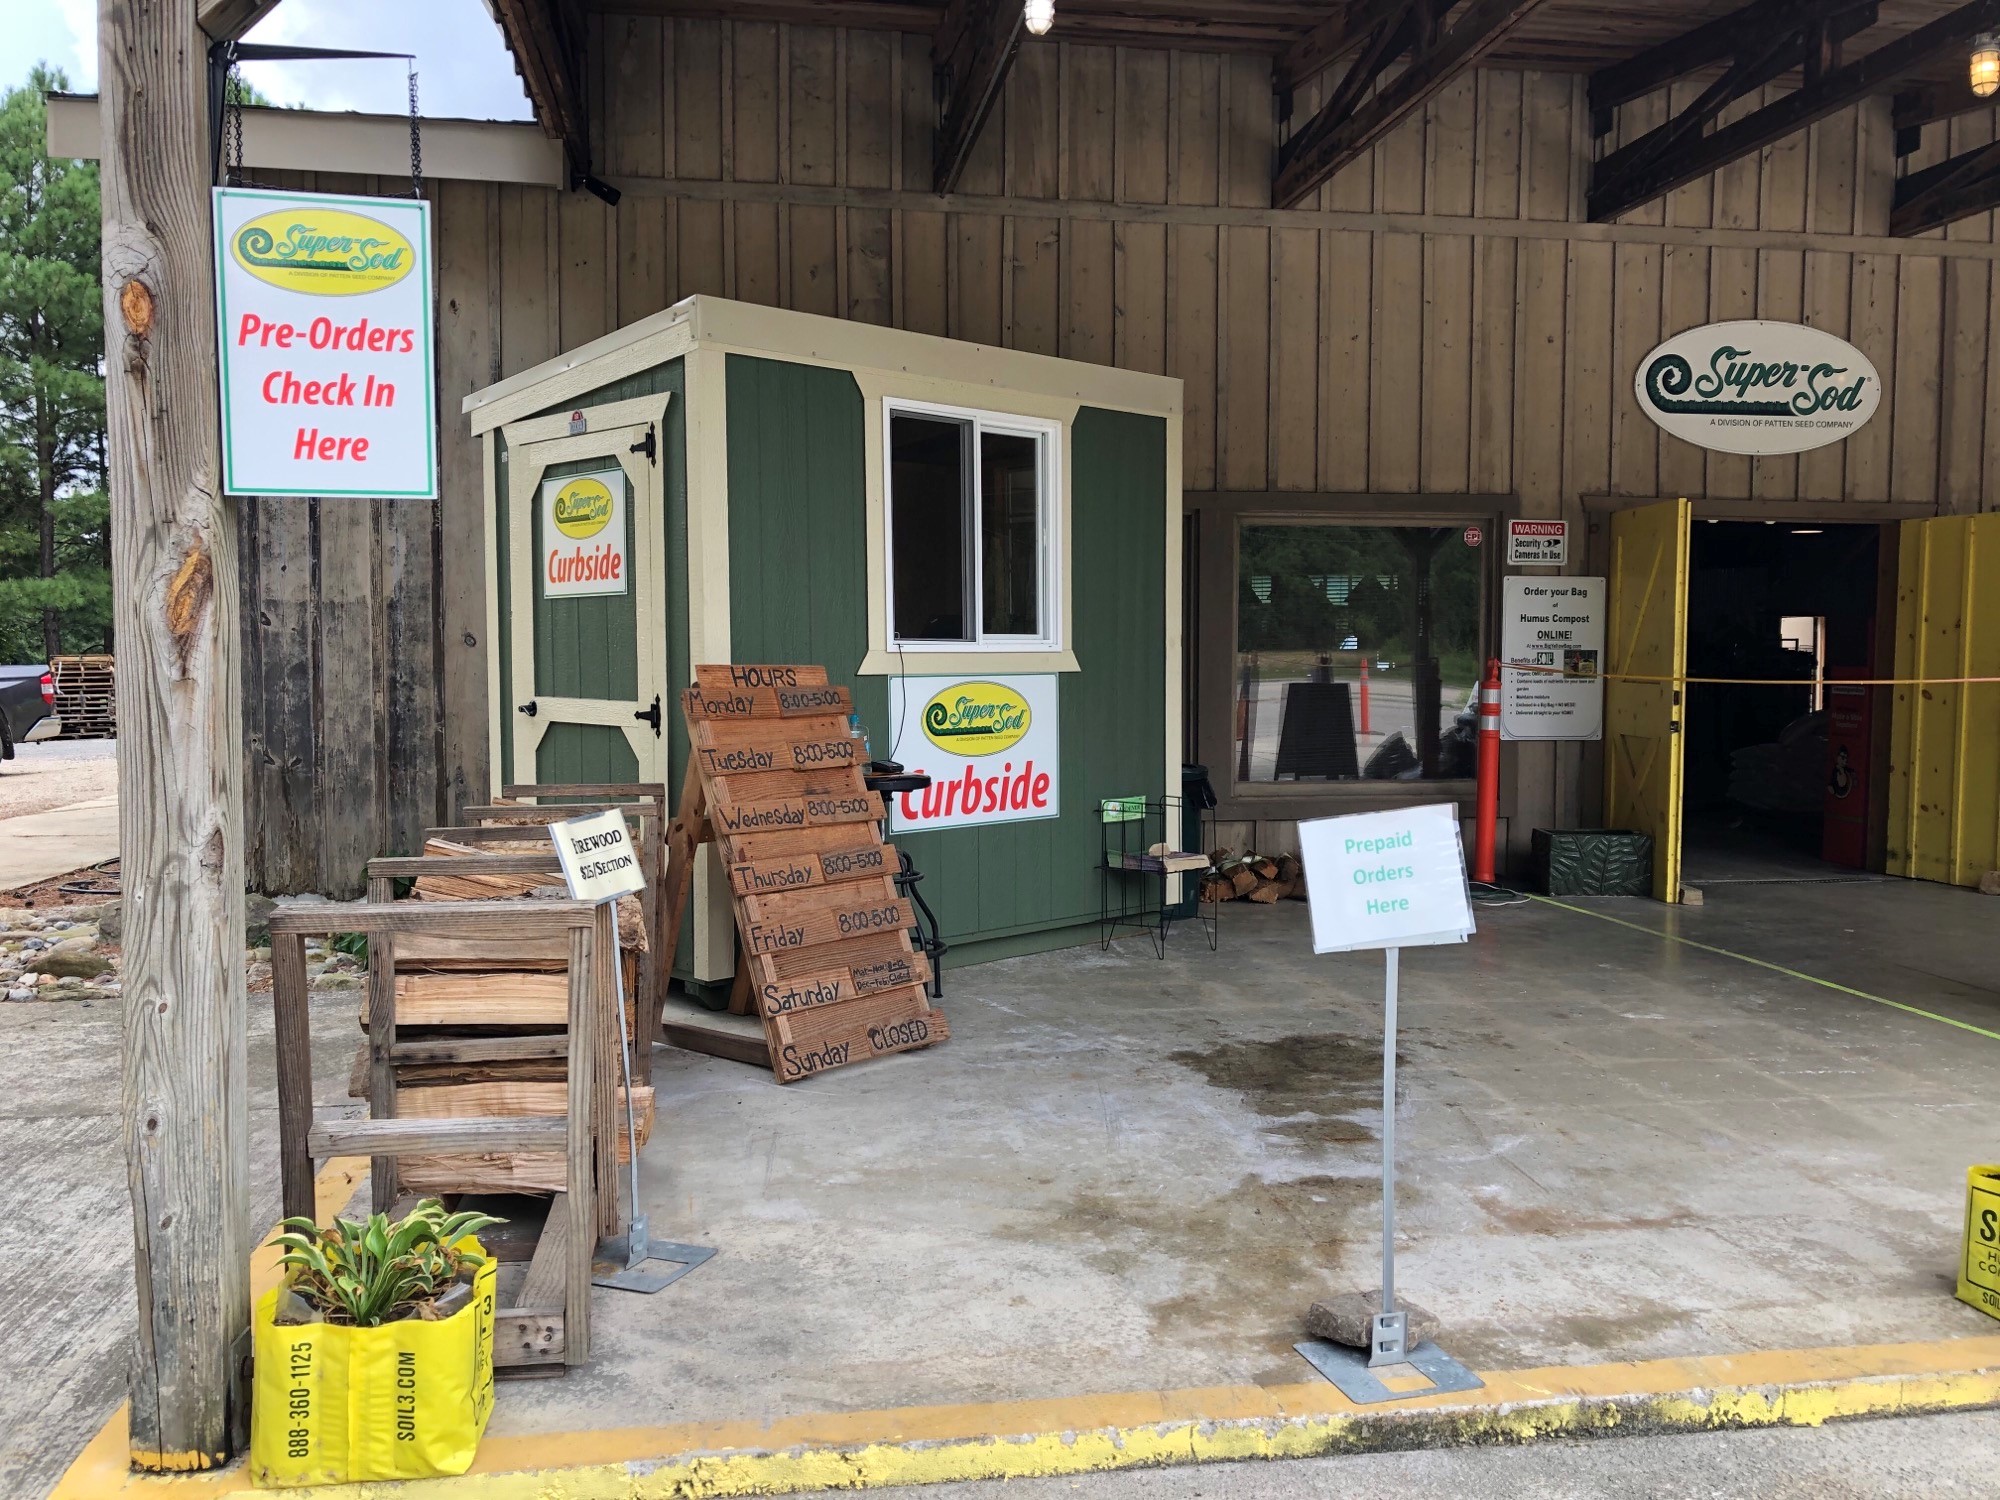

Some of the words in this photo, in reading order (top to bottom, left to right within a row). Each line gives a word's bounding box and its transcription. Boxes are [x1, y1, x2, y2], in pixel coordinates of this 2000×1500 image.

[238, 313, 415, 353] Pre-Orders
[262, 371, 357, 406] Check
[363, 375, 395, 407] In
[1709, 418, 1716, 426] A
[1717, 419, 1751, 427] DIVISION
[1752, 419, 1763, 427] OF
[1765, 420, 1793, 428] PATTEN
[1794, 420, 1815, 428] SEED
[1816, 420, 1853, 428] COMPANY
[293, 428, 369, 461] Here
[1515, 524, 1563, 535] WARNING
[1514, 549, 1540, 560] Cameras
[1541, 550, 1548, 560] In
[1549, 550, 1561, 560] Use
[1515, 538, 1541, 550] Security
[548, 543, 622, 584] Curbside
[1524, 586, 1548, 596] Order
[1550, 588, 1569, 598] your
[1571, 587, 1588, 598] Bag
[1520, 613, 1550, 623] Humus
[1552, 614, 1590, 625] Compost
[1537, 630, 1573, 640] ONLINE!
[730, 666, 797, 688] HOURS
[689, 691, 754, 715] Monday
[779, 691, 841, 709] 8:00-5:00
[702, 747, 774, 772] Tuesday
[793, 741, 854, 764] 8:00-5:00
[719, 804, 805, 830] Wednesday
[808, 798, 869, 816] 8:00-5:00
[571, 829, 622, 855] FIREWOOD
[1345, 830, 1413, 855] Prepaid
[734, 863, 812, 891] Thursday
[822, 850, 883, 876] 8:00-5:00
[1353, 865, 1414, 885] Orders
[1366, 898, 1410, 915] Here
[750, 925, 804, 952] Friday
[838, 905, 901, 933] 8:00-5:00
[888, 969, 911, 982] Closed
[764, 980, 839, 1015] Saturday
[782, 1041, 850, 1076] Sunday
[869, 1018, 928, 1051] CLOSED
[288, 1341, 313, 1459] 888-360-1125
[397, 1351, 416, 1442] SOIL3.COM
